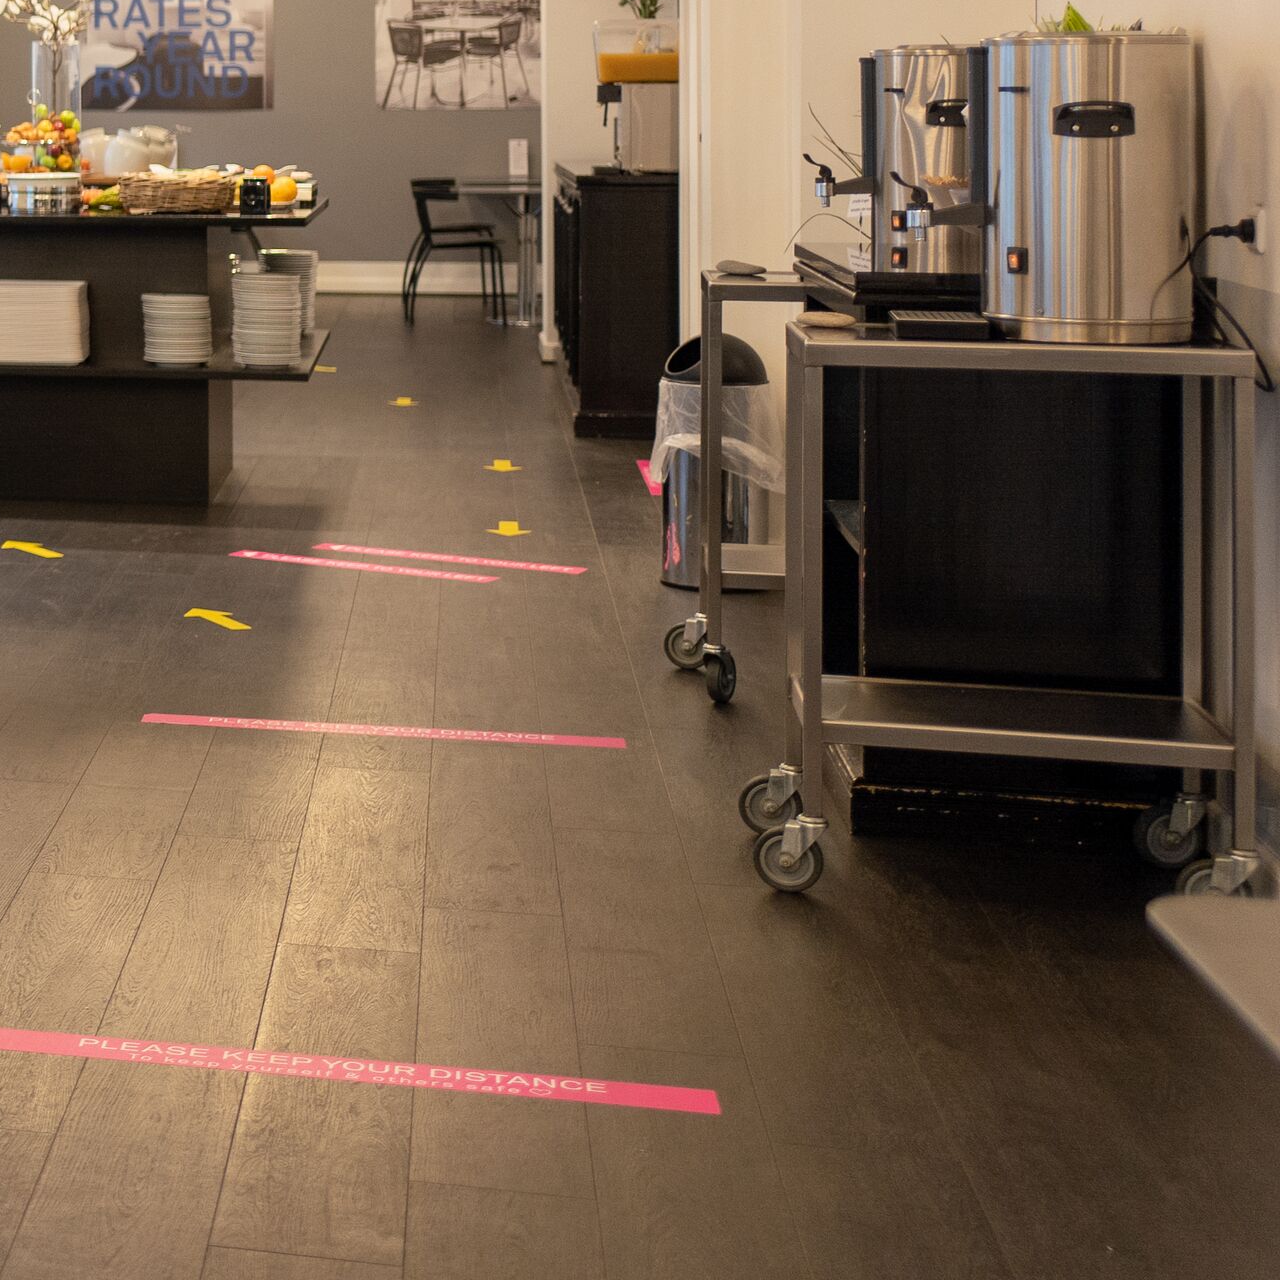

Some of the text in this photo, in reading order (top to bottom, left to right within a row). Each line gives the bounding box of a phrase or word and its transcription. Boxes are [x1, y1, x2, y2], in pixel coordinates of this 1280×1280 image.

[137, 30, 256, 63] YEAR
[93, 65, 249, 99] ROUND
[209, 717, 294, 727] PLEASE
[304, 722, 367, 731] KEEP
[370, 726, 432, 734] YOUR
[441, 729, 555, 740] DISTANCE
[79, 1038, 607, 1093] PLEASE KEEP YOUR DISTANCE
[129, 1053, 153, 1062] To
[164, 1057, 220, 1068] keep
[231, 1063, 333, 1077] yourself
[372, 1075, 454, 1088] others
[466, 1083, 520, 1094] safe
